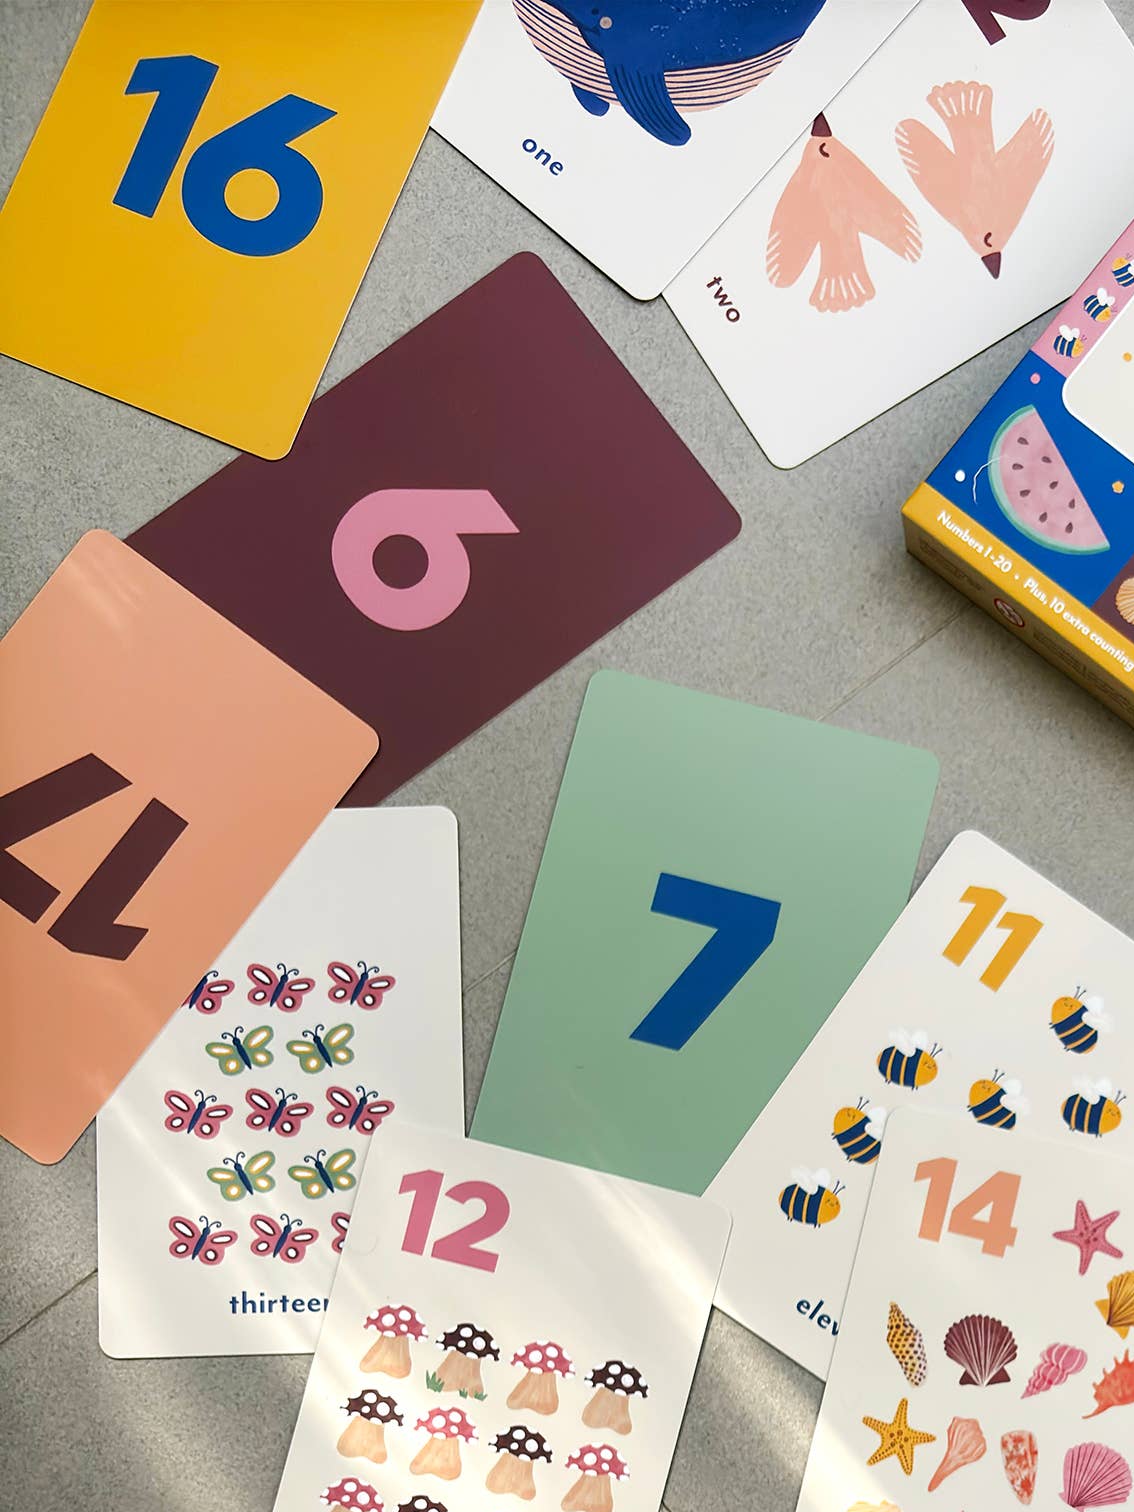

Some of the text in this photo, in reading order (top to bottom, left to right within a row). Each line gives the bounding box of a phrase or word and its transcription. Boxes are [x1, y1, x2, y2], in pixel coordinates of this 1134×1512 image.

[113, 55, 337, 256] 16
[522, 138, 564, 176] one
[706, 276, 740, 323] two
[332, 489, 519, 631] 6
[936, 509, 985, 553] Numbers
[1023, 576, 1048, 605] Plus,
[1049, 596, 1065, 614] 10
[1062, 612, 1091, 636] extra
[1090, 632, 1134, 673] counting
[629, 872, 782, 1051] 7
[942, 886, 1043, 992] 11
[399, 1169, 511, 1273] 12
[914, 1157, 1022, 1258] 14
[796, 1299, 840, 1336] elev
